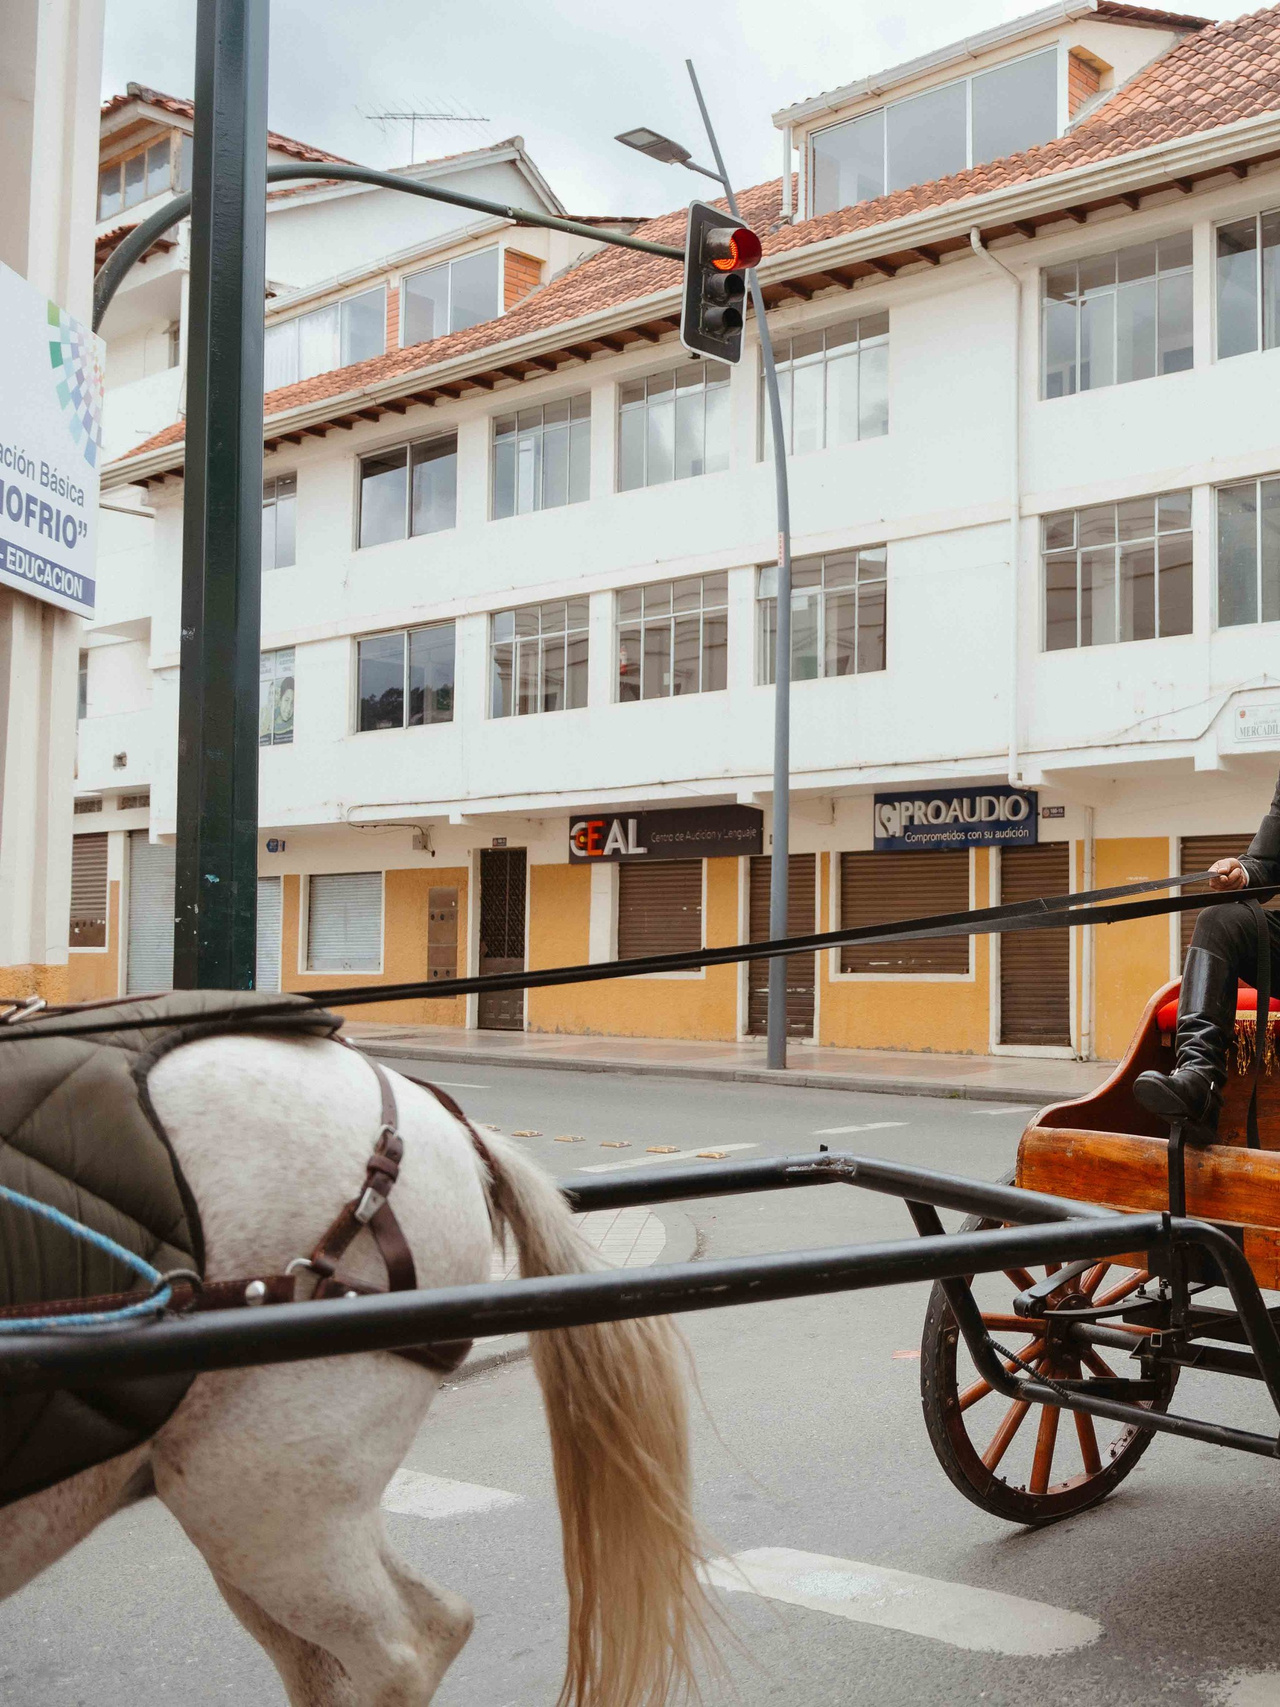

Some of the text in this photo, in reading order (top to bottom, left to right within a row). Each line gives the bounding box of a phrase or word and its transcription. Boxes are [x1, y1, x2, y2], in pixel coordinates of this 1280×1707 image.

[0, 442, 85, 507] ción Básica
[6, 545, 83, 599] EDUCACION
[901, 794, 1030, 826] PROAUDIO
[570, 818, 648, 858] CEAL
[651, 832, 673, 843] Centro
[675, 832, 684, 842] de
[717, 831, 722, 840] y
[905, 825, 1029, 844] Comprometidos con su audición
